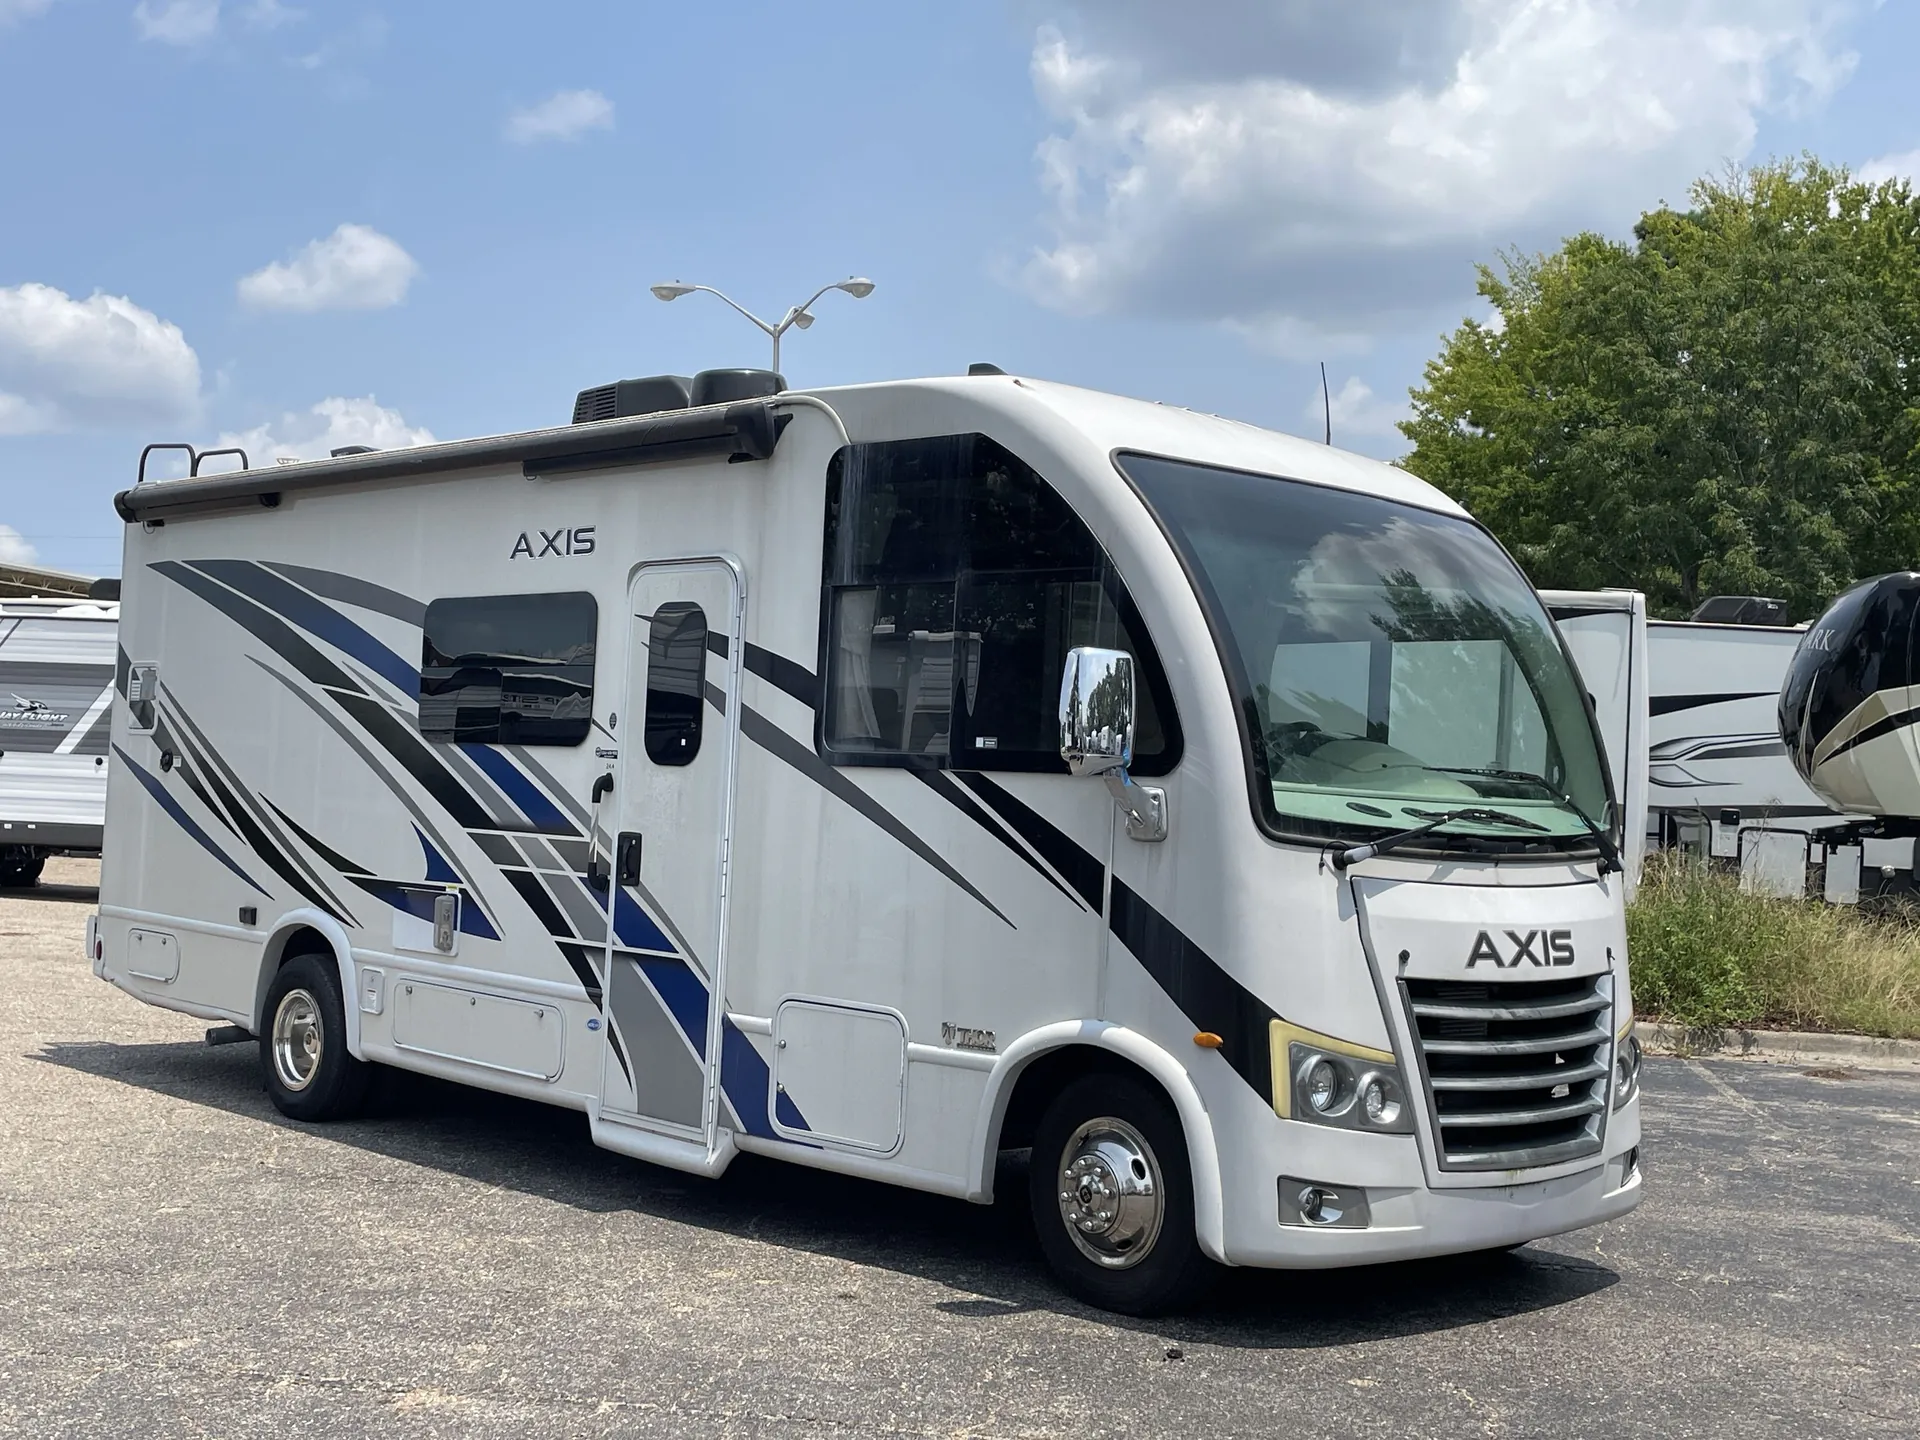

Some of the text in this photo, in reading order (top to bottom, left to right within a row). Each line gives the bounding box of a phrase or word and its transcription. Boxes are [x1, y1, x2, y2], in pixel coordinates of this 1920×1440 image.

[509, 525, 596, 561] AXIS
[20, 711, 69, 722] FLIGHT
[1464, 928, 1575, 969] AXIS
